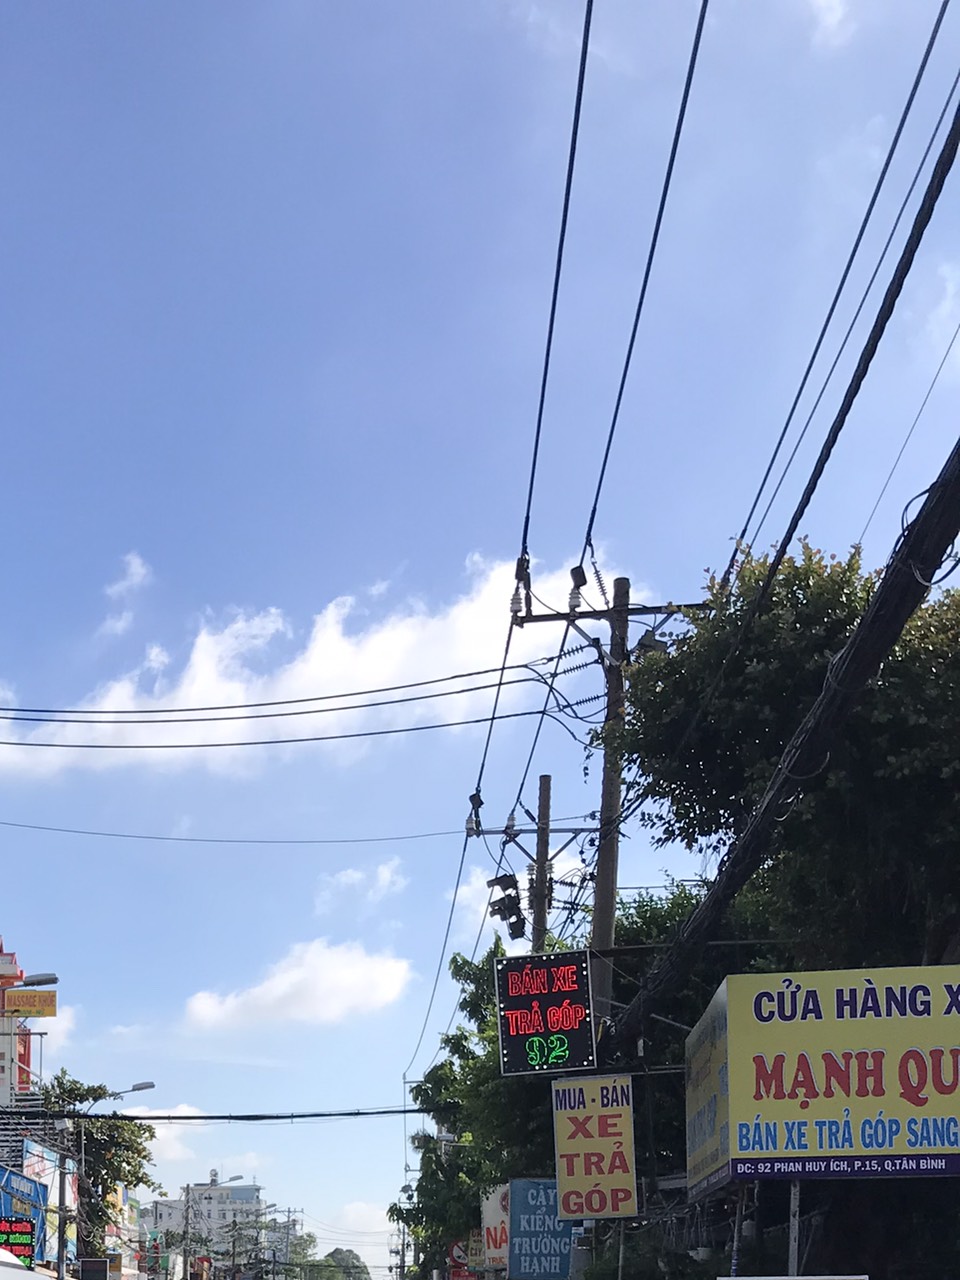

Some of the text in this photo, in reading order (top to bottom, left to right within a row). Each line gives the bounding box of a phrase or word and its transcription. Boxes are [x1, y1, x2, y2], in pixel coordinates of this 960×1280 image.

[508, 964, 579, 997] BÁN XE
[753, 978, 824, 1023] CỬA
[835, 978, 932, 1020] HÀNG
[505, 1000, 585, 1035] TRẢ GÓP
[525, 1034, 570, 1067] 92
[555, 1081, 631, 1111] MUA BÁN
[752, 1049, 887, 1111] MẠNH
[566, 1113, 624, 1141] XE
[738, 1114, 779, 1153] BÁN
[783, 1119, 809, 1151] XE
[814, 1107, 854, 1151] TRẢ
[860, 1110, 901, 1150] GÓP
[906, 1116, 960, 1149] SANG
[559, 1141, 631, 1178] TRẢ
[737, 1156, 946, 1174] ĐC: 92 PHAN HUY ÍCH, P.15, Q.TÂN BÌNH
[527, 1186, 556, 1206] CÂY
[561, 1182, 633, 1216] GÓP
[513, 1233, 570, 1255] TRƯỜNG
[520, 1256, 561, 1277] HẠNH
